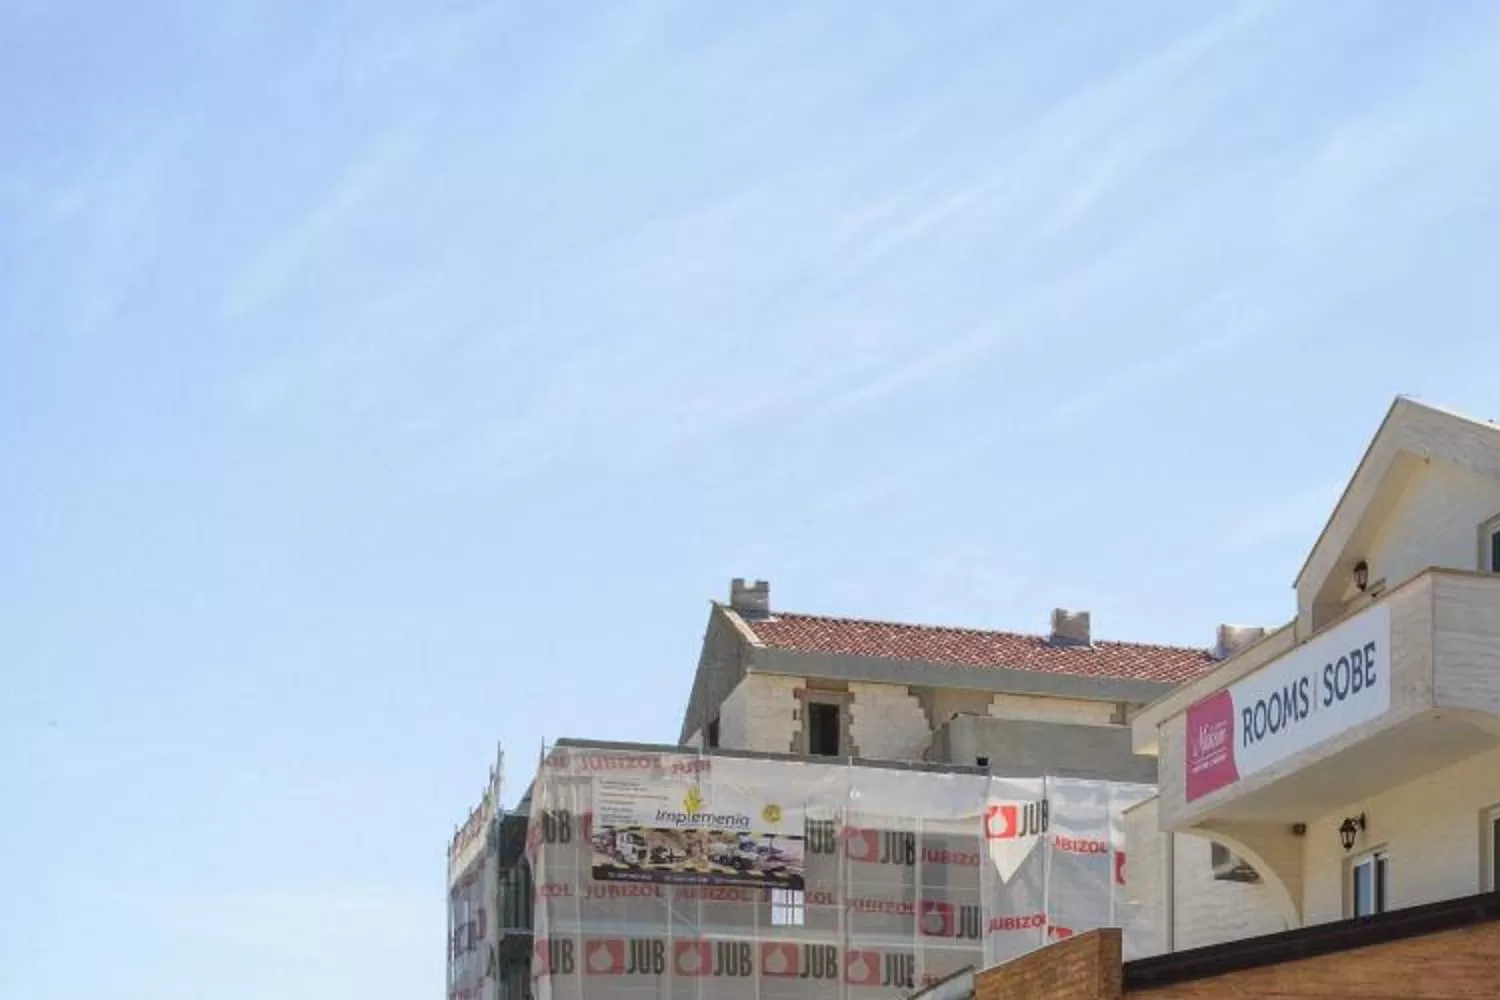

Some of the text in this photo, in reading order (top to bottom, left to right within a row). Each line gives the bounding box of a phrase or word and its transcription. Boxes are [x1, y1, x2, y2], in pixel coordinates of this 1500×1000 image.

[1242, 676, 1309, 747] ROOMS
[1323, 640, 1377, 706] SOBE
[1018, 799, 1049, 837] JUB
[880, 831, 915, 866] JUB
[956, 902, 983, 940] JU
[627, 938, 666, 976] JUB
[713, 941, 754, 977] JUB
[800, 942, 838, 979] JUB
